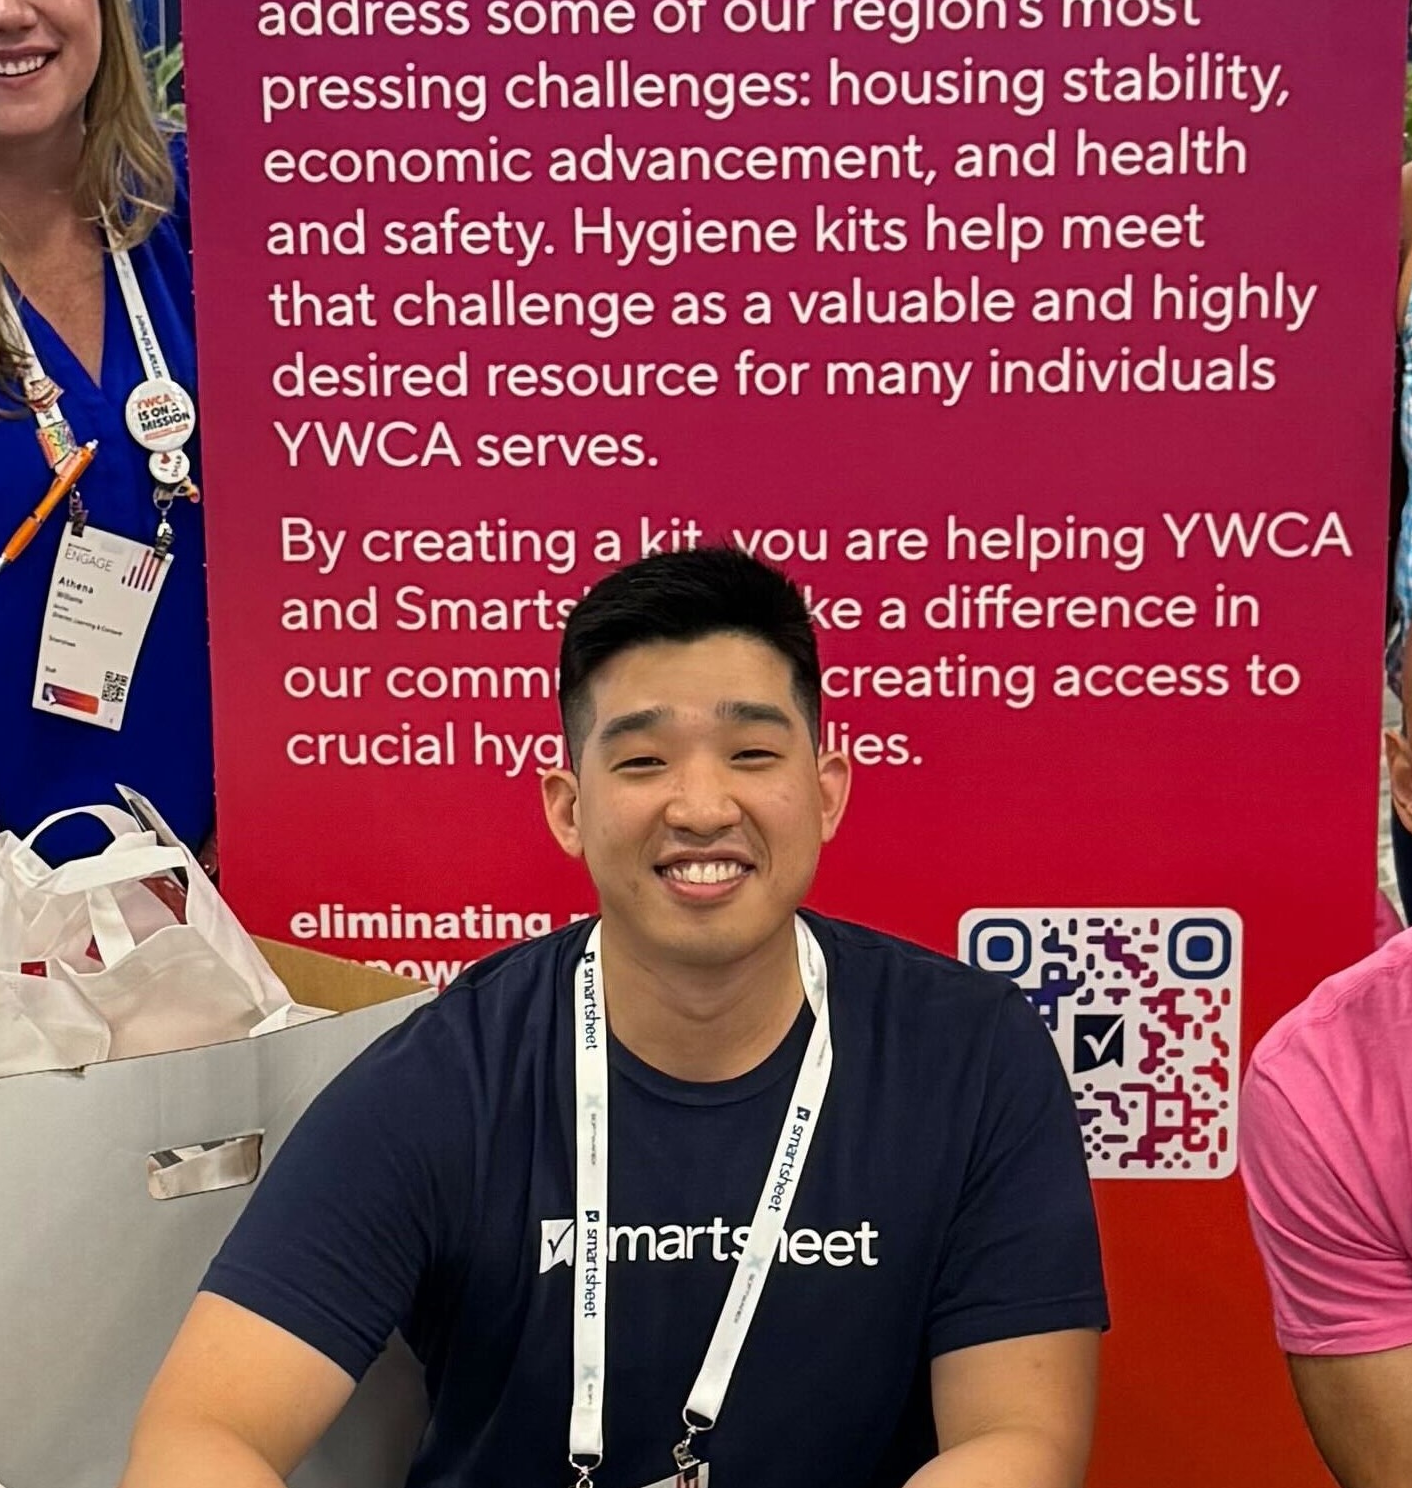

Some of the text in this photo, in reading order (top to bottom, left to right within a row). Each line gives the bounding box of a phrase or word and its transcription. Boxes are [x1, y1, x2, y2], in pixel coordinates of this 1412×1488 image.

[487, 0, 636, 35] some
[262, 51, 1289, 123] pressing challenges: housing stability,
[264, 126, 1246, 186] economic advancement, and health
[267, 202, 1205, 267] and safety. Hygiene kits help meet
[268, 271, 1317, 338] that challenge as a valuable and highly
[272, 344, 1276, 407] desired resource for many individuals
[273, 421, 658, 467] YWCA serves.
[281, 511, 1353, 574] By creating a you are helping YWCA
[281, 583, 1260, 631] and Smarts a difference in
[284, 666, 371, 699] our
[820, 653, 1036, 709] creating
[1052, 664, 1230, 698] access
[1246, 654, 1301, 696] to
[286, 722, 454, 766] crucial
[289, 903, 553, 941] eliminating
[584, 967, 601, 1051] smartsheet
[606, 1217, 879, 1267] martseet
